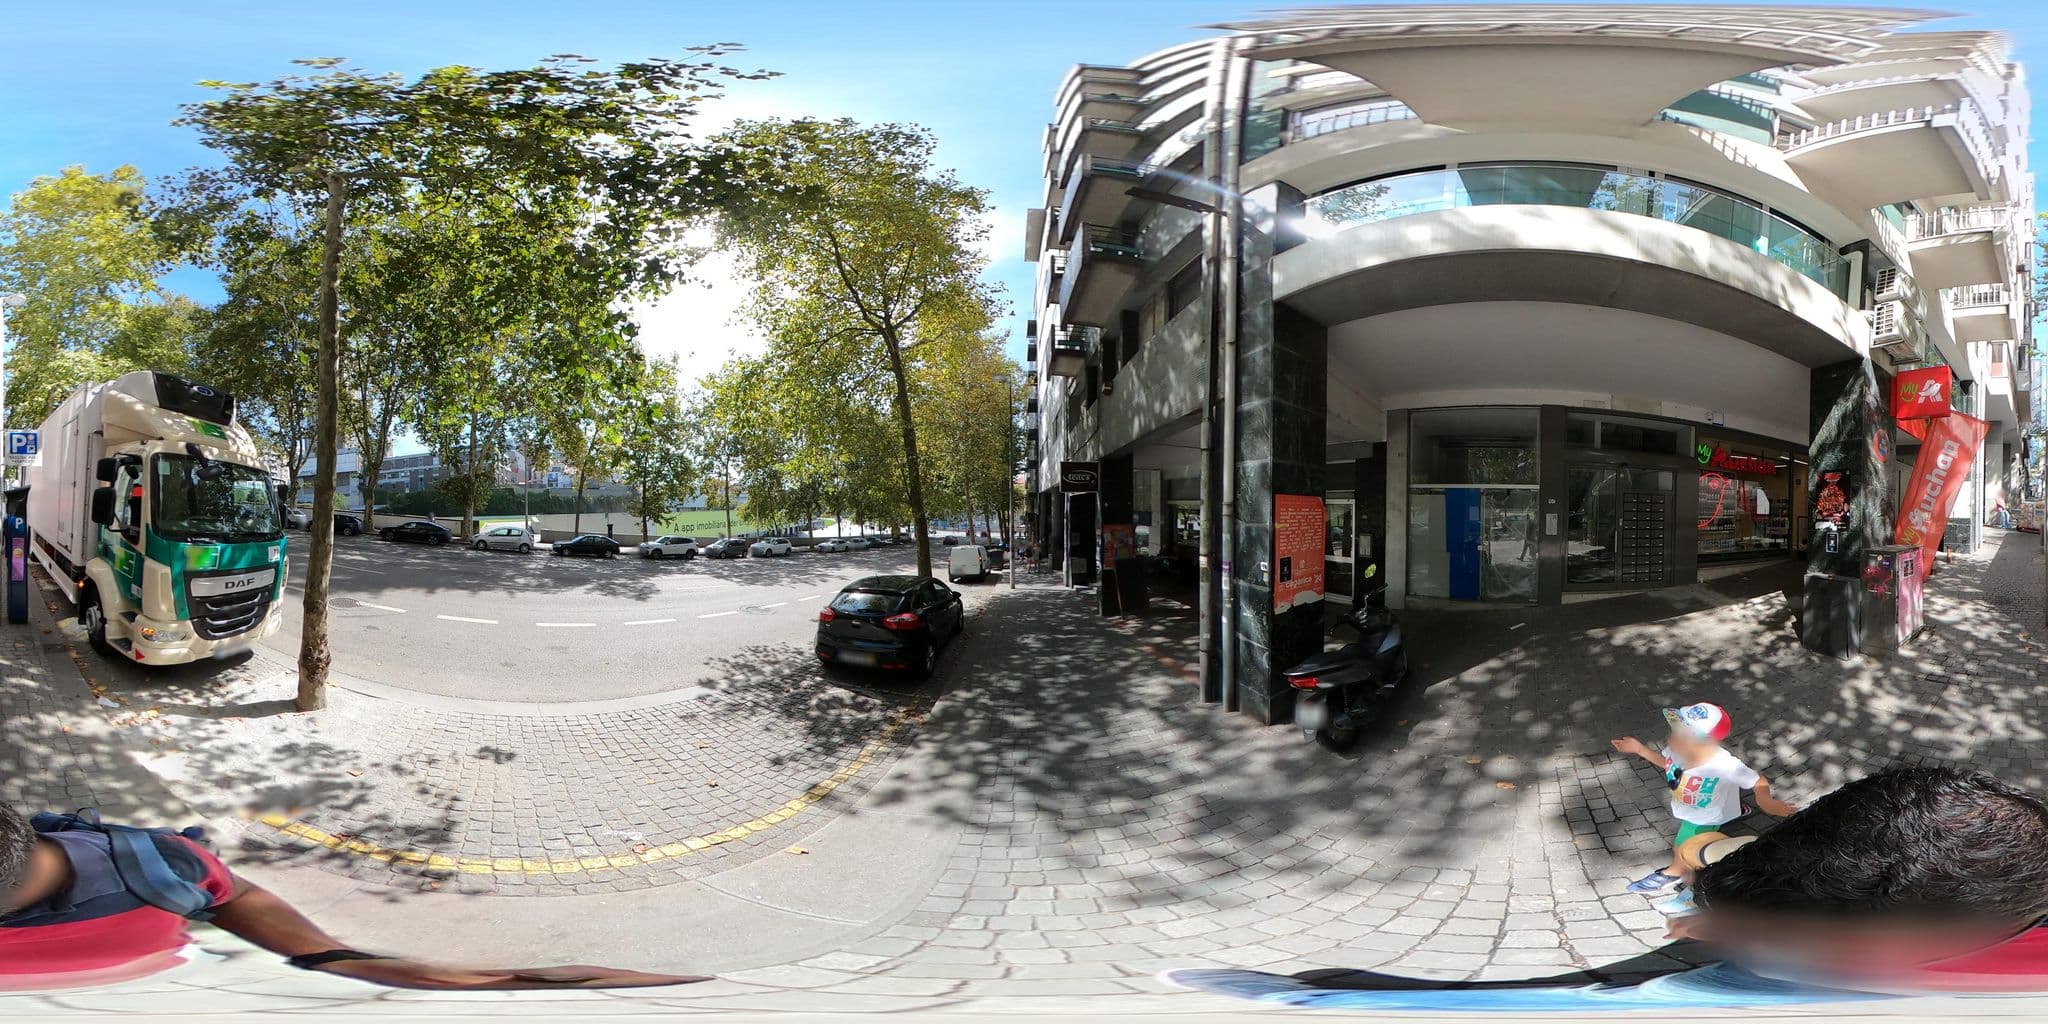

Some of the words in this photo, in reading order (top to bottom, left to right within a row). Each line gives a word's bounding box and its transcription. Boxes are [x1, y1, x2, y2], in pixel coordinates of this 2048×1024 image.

[1901, 384, 1918, 402] My
[12, 434, 27, 453] P
[1697, 443, 1711, 464] My
[15, 517, 24, 529] P
[674, 523, 679, 533] A
[682, 524, 695, 533] app
[1901, 526, 1921, 545] My
[225, 577, 256, 590] DAF
